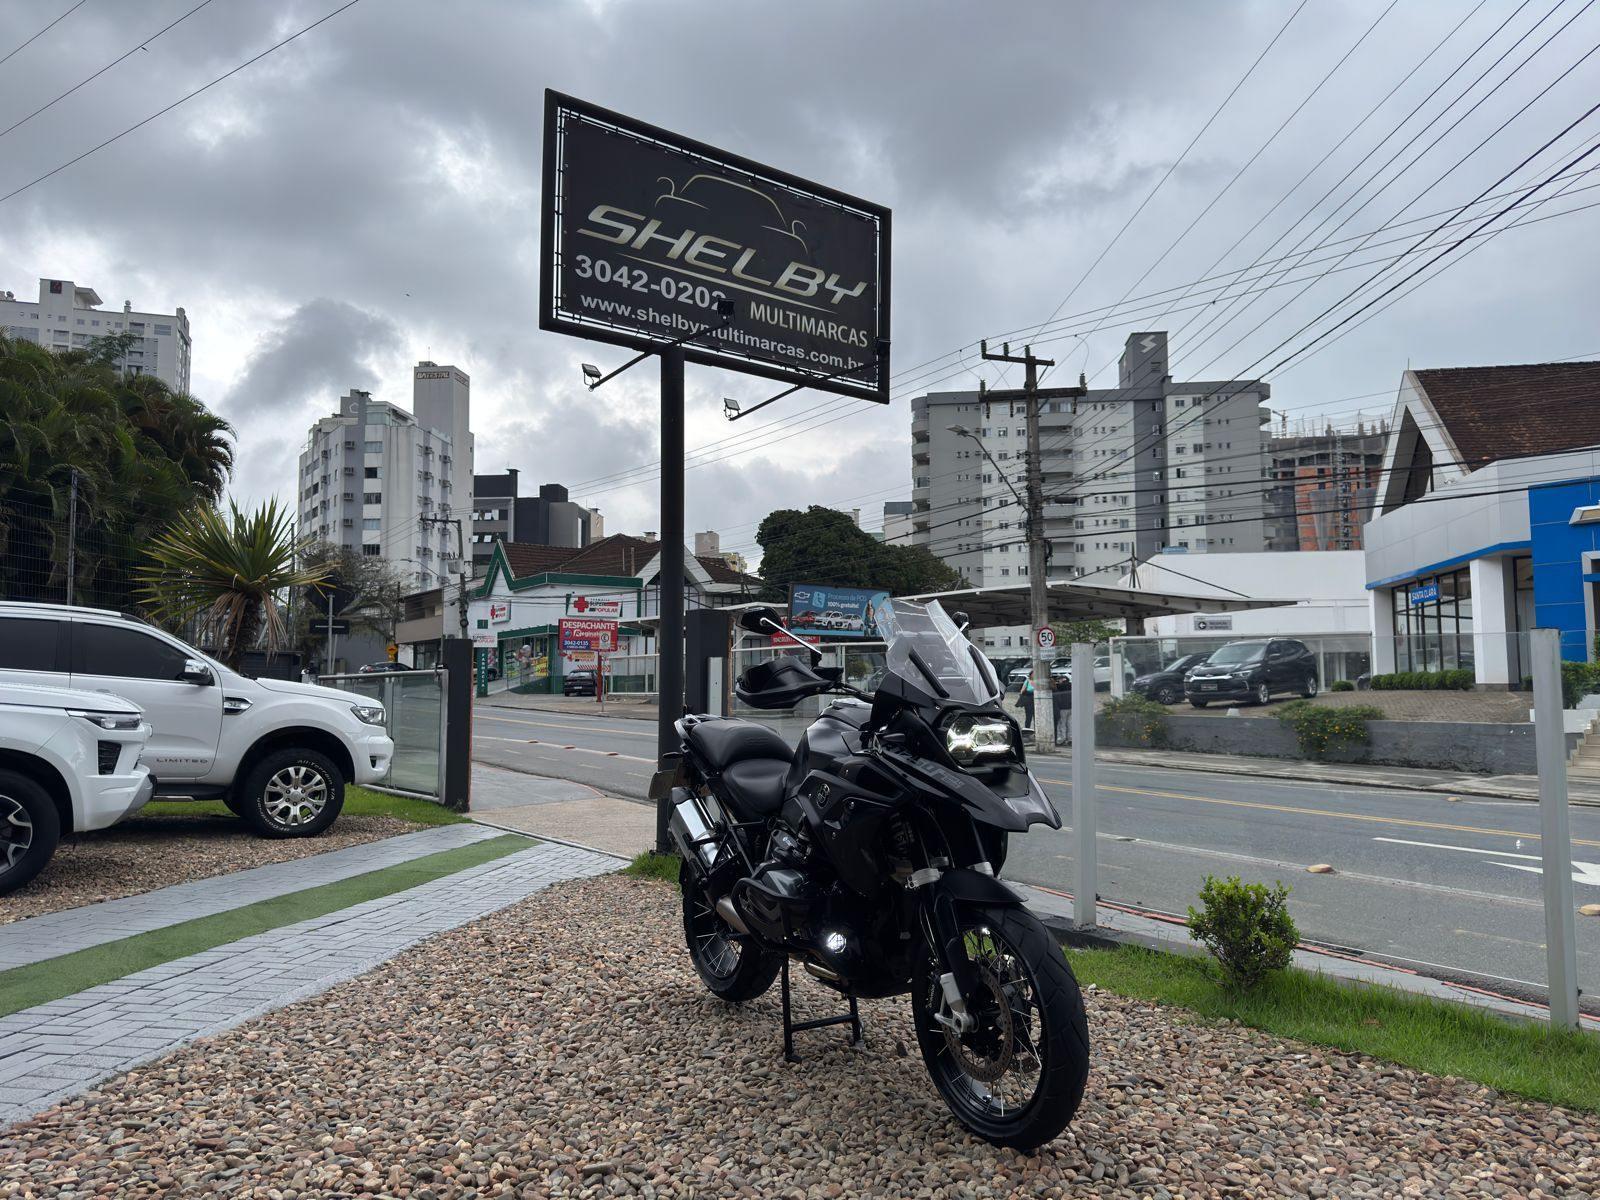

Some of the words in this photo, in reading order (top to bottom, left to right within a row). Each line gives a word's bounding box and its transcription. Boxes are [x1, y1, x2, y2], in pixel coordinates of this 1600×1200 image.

[576, 205, 868, 305] SHELBY
[750, 301, 868, 348] MULTIMARCAS
[562, 621, 616, 630] DESPACHANTE
[1041, 632, 1053, 642] 50
